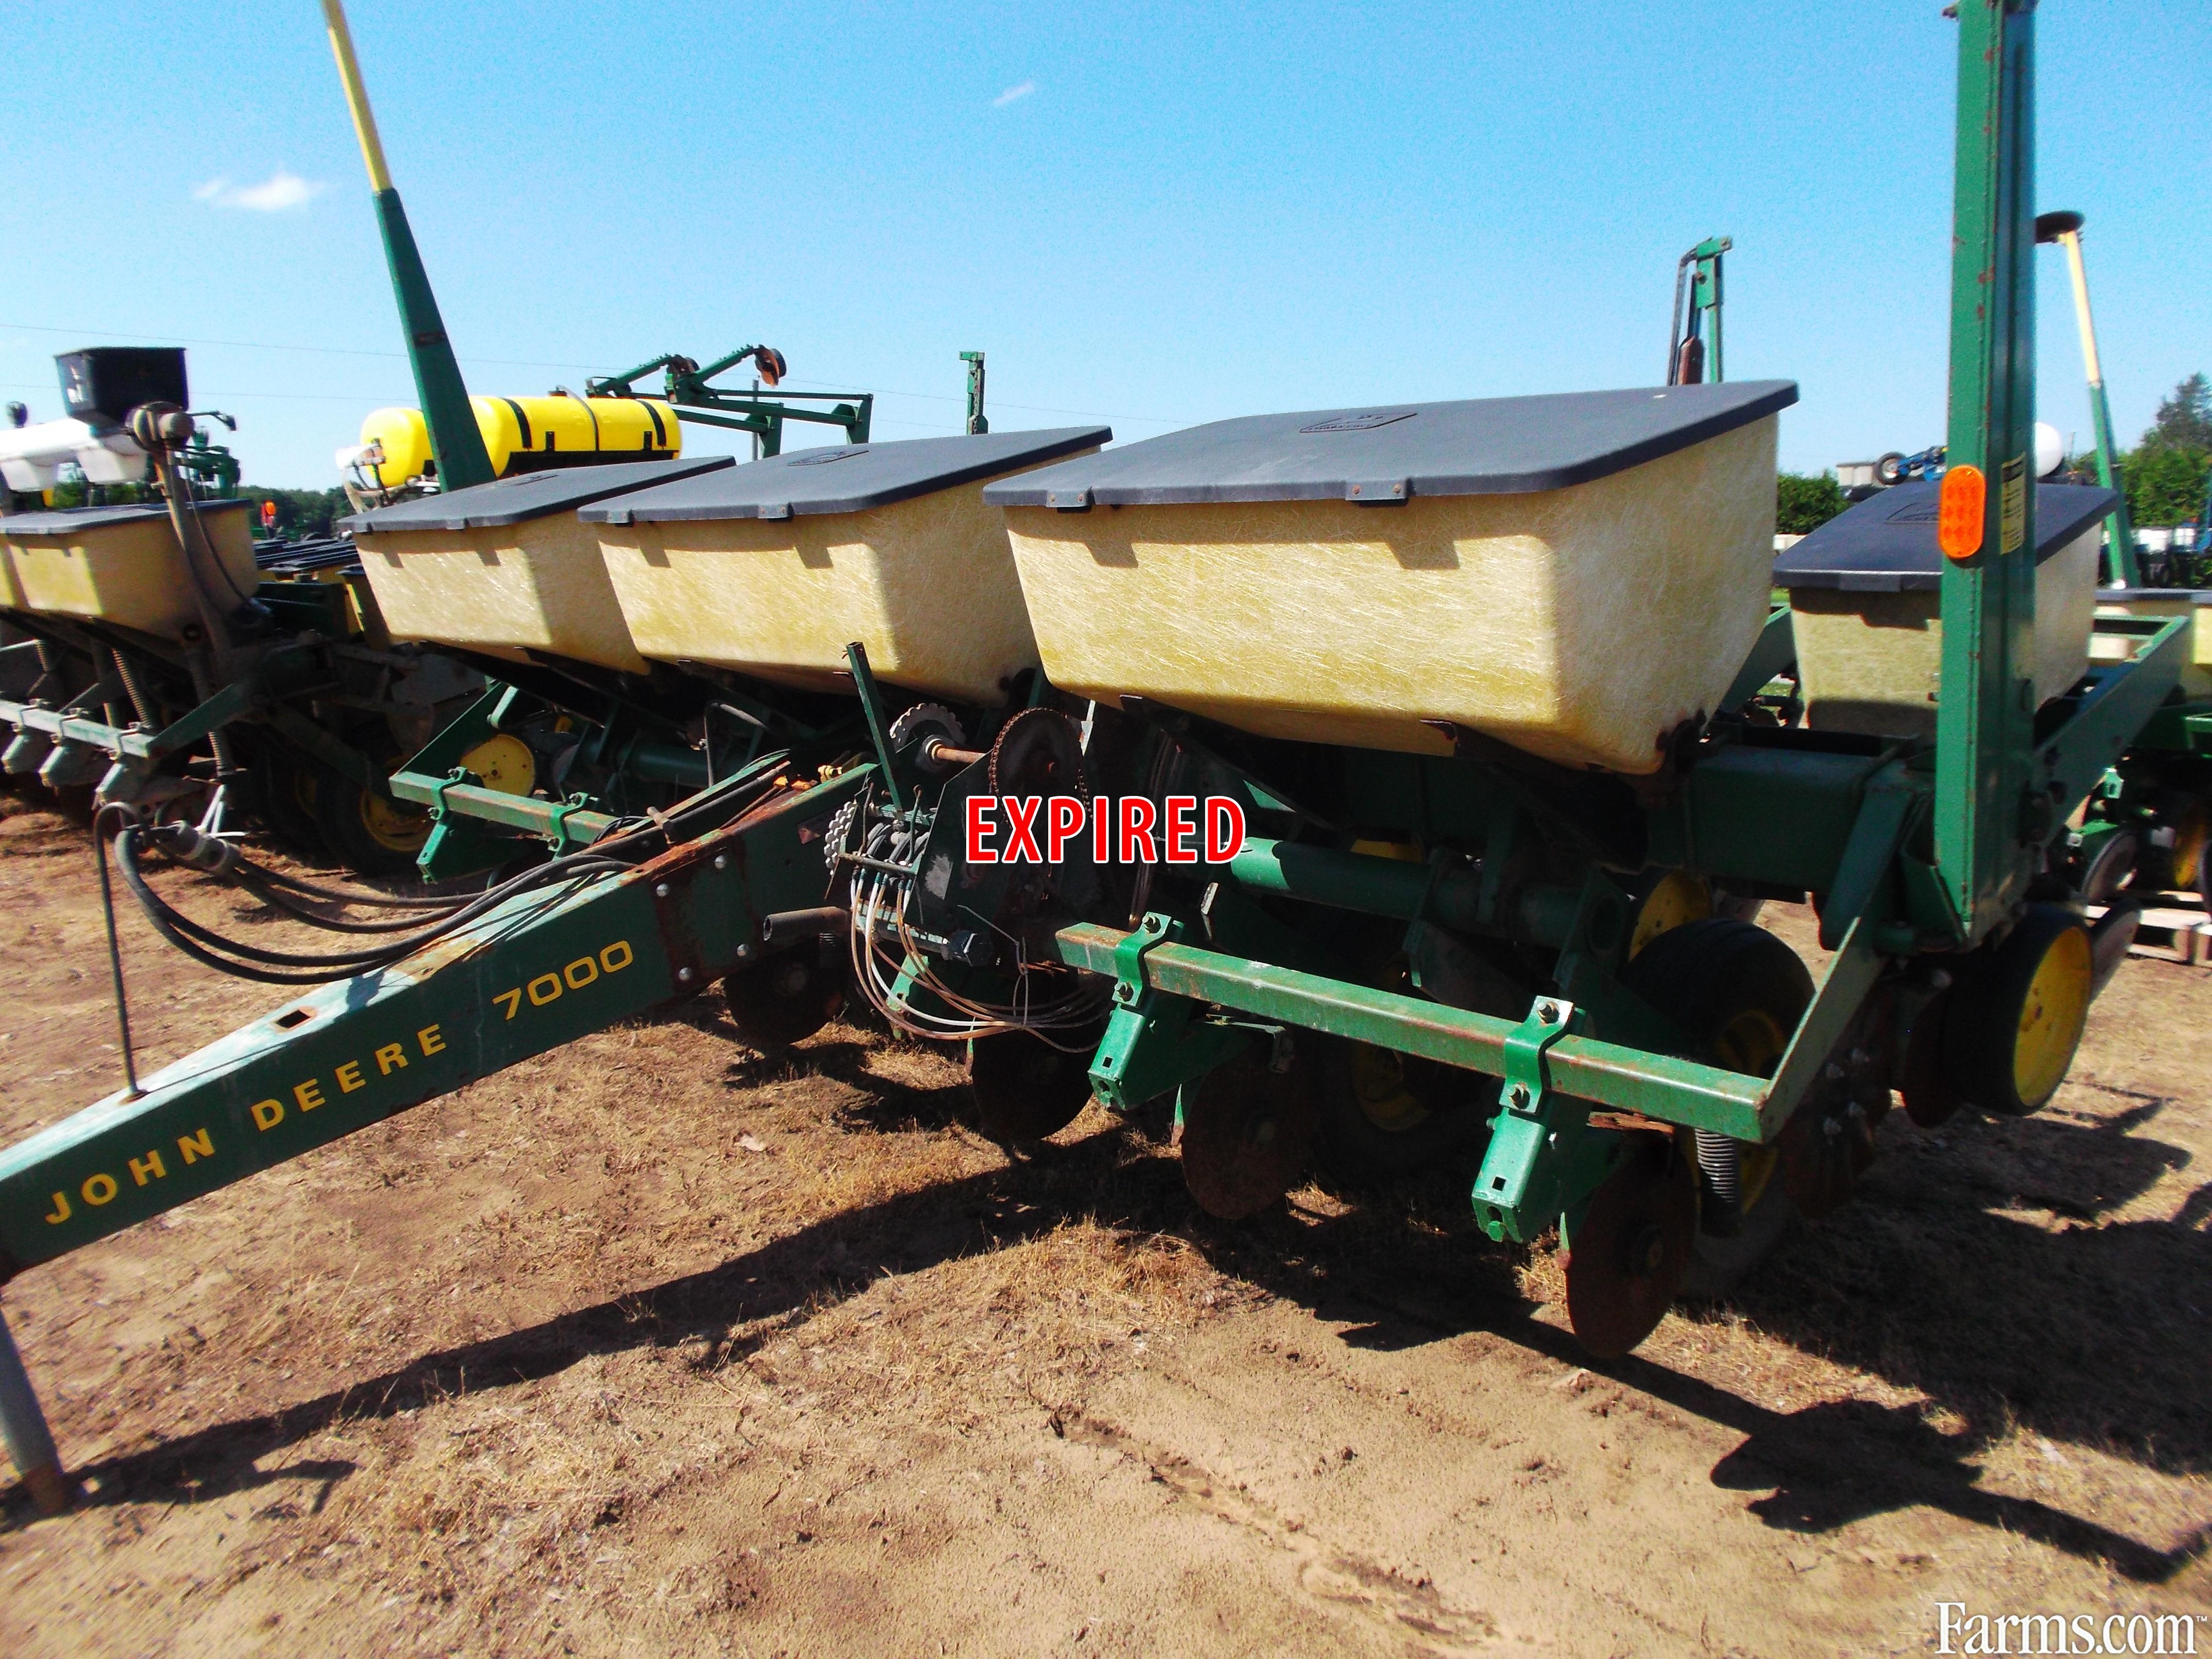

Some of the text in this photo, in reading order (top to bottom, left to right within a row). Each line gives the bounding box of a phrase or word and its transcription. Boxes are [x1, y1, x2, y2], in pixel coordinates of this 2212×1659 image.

[47, 940, 633, 1225] JOHN DEERE 7000
